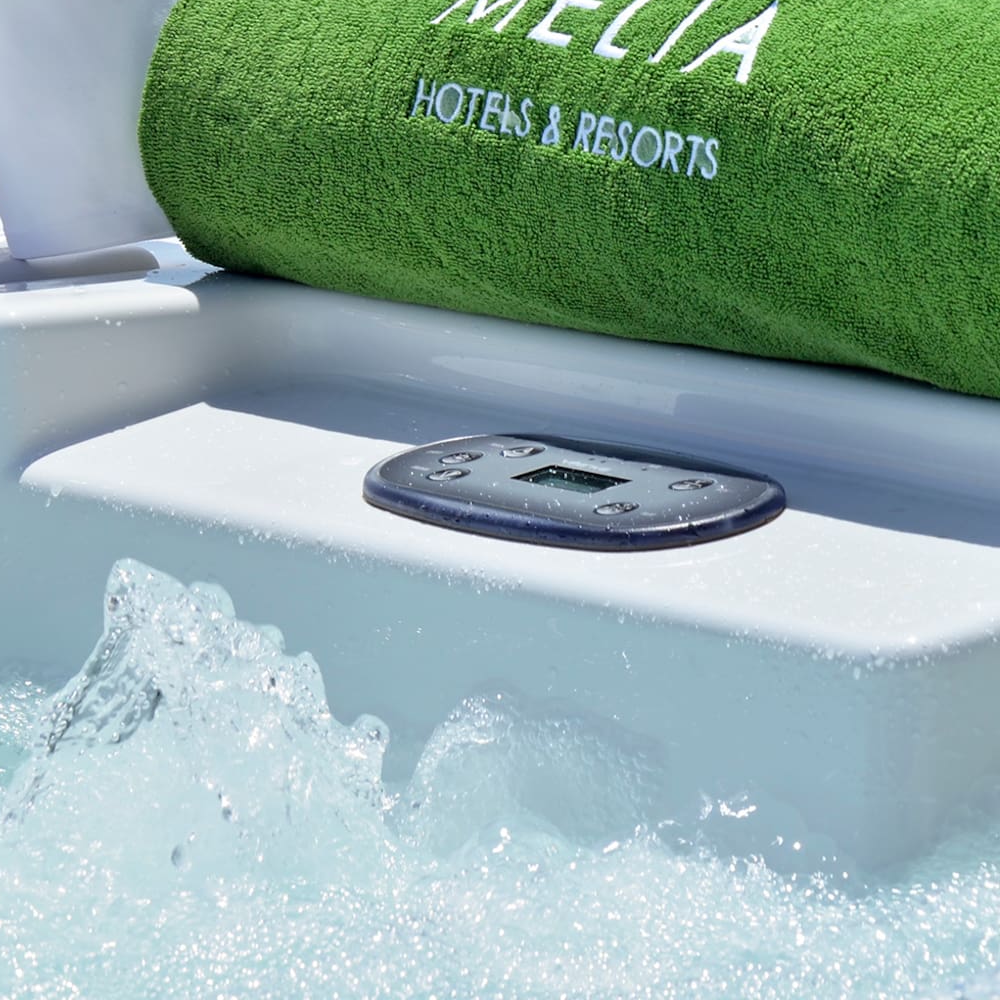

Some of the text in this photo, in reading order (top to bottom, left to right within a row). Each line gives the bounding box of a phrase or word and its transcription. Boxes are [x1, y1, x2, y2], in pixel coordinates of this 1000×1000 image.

[410, 78, 719, 180] HOTELS & RESORTS
